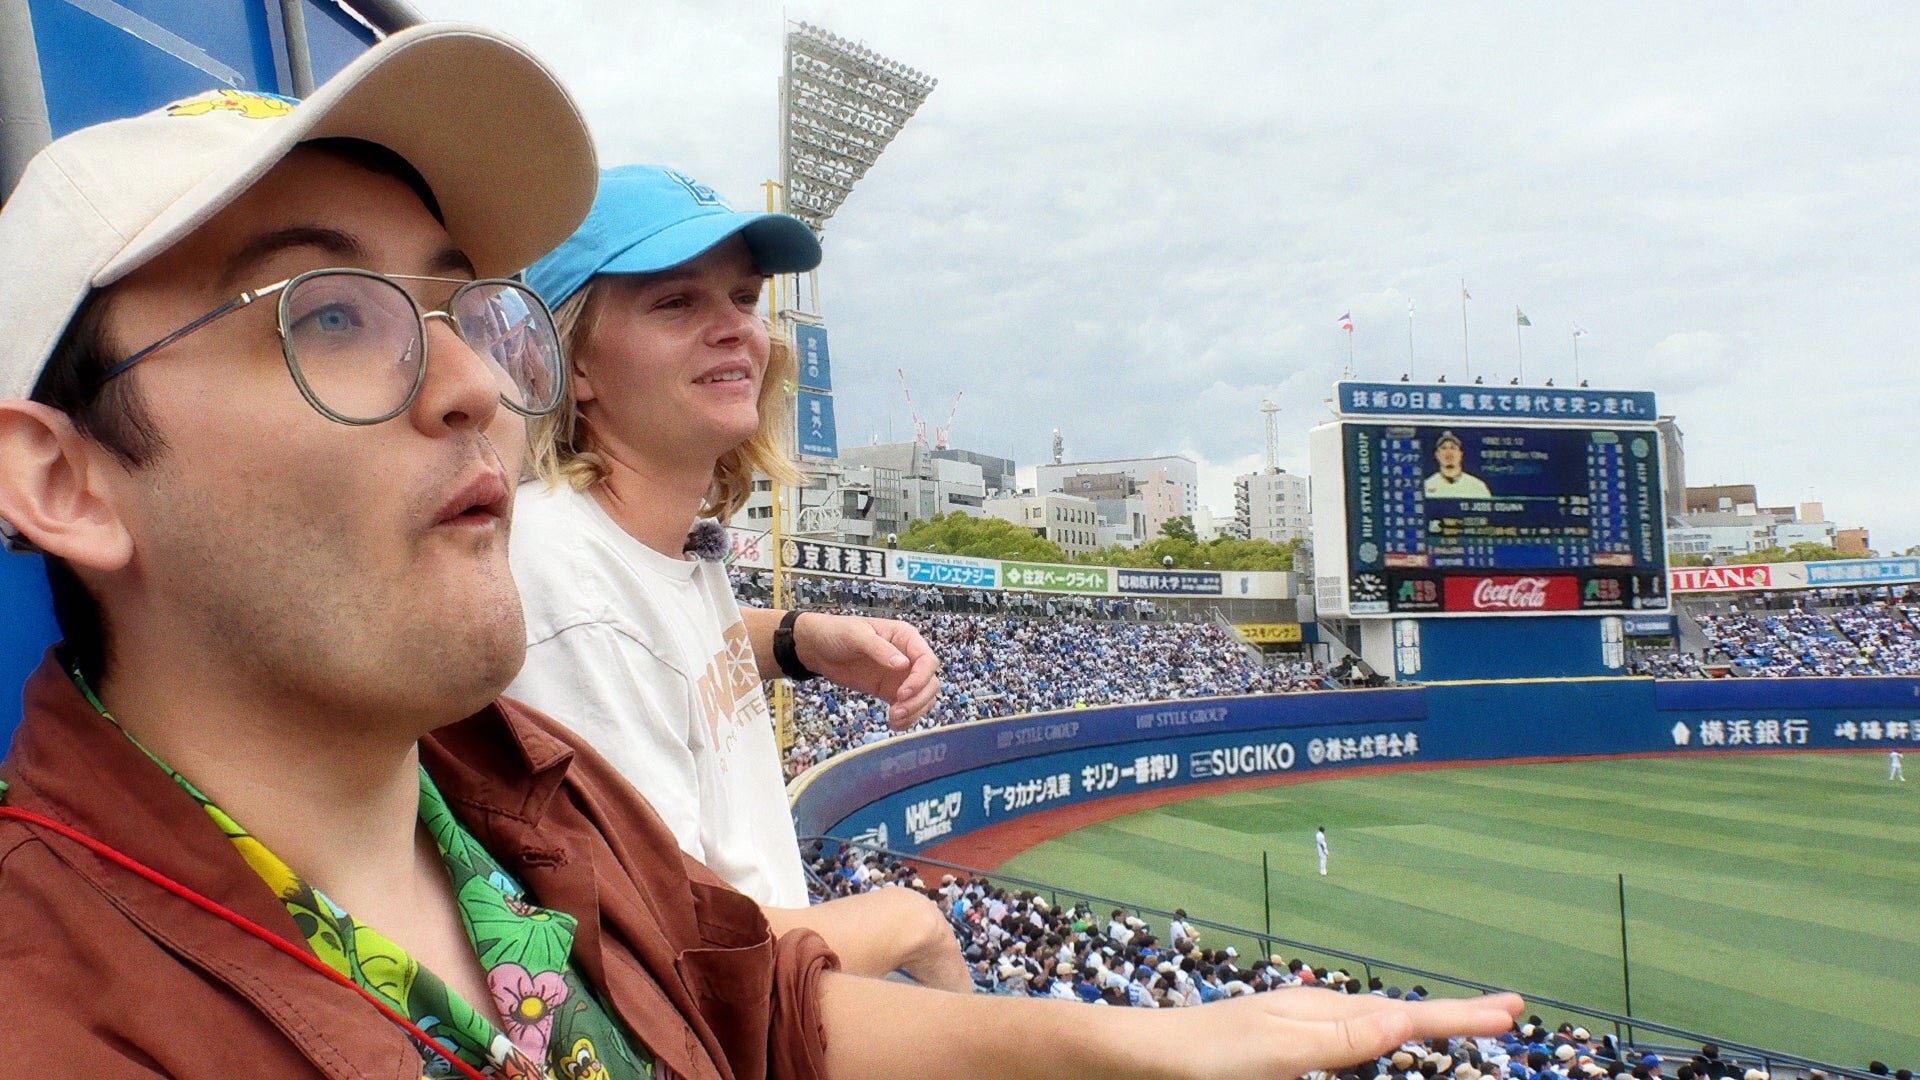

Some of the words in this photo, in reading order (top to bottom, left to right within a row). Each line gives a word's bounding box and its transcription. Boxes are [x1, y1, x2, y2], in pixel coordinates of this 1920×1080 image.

[1700, 719, 1810, 746] 横浜銀行
[1834, 720, 1909, 741] 崎陽軒
[1212, 742, 1295, 776] SUGIKO
[1326, 732, 1420, 763] 横浜信用金庫
[1082, 754, 1179, 792] キリン一番搾り
[1003, 773, 1071, 811] タカナシ乳業
